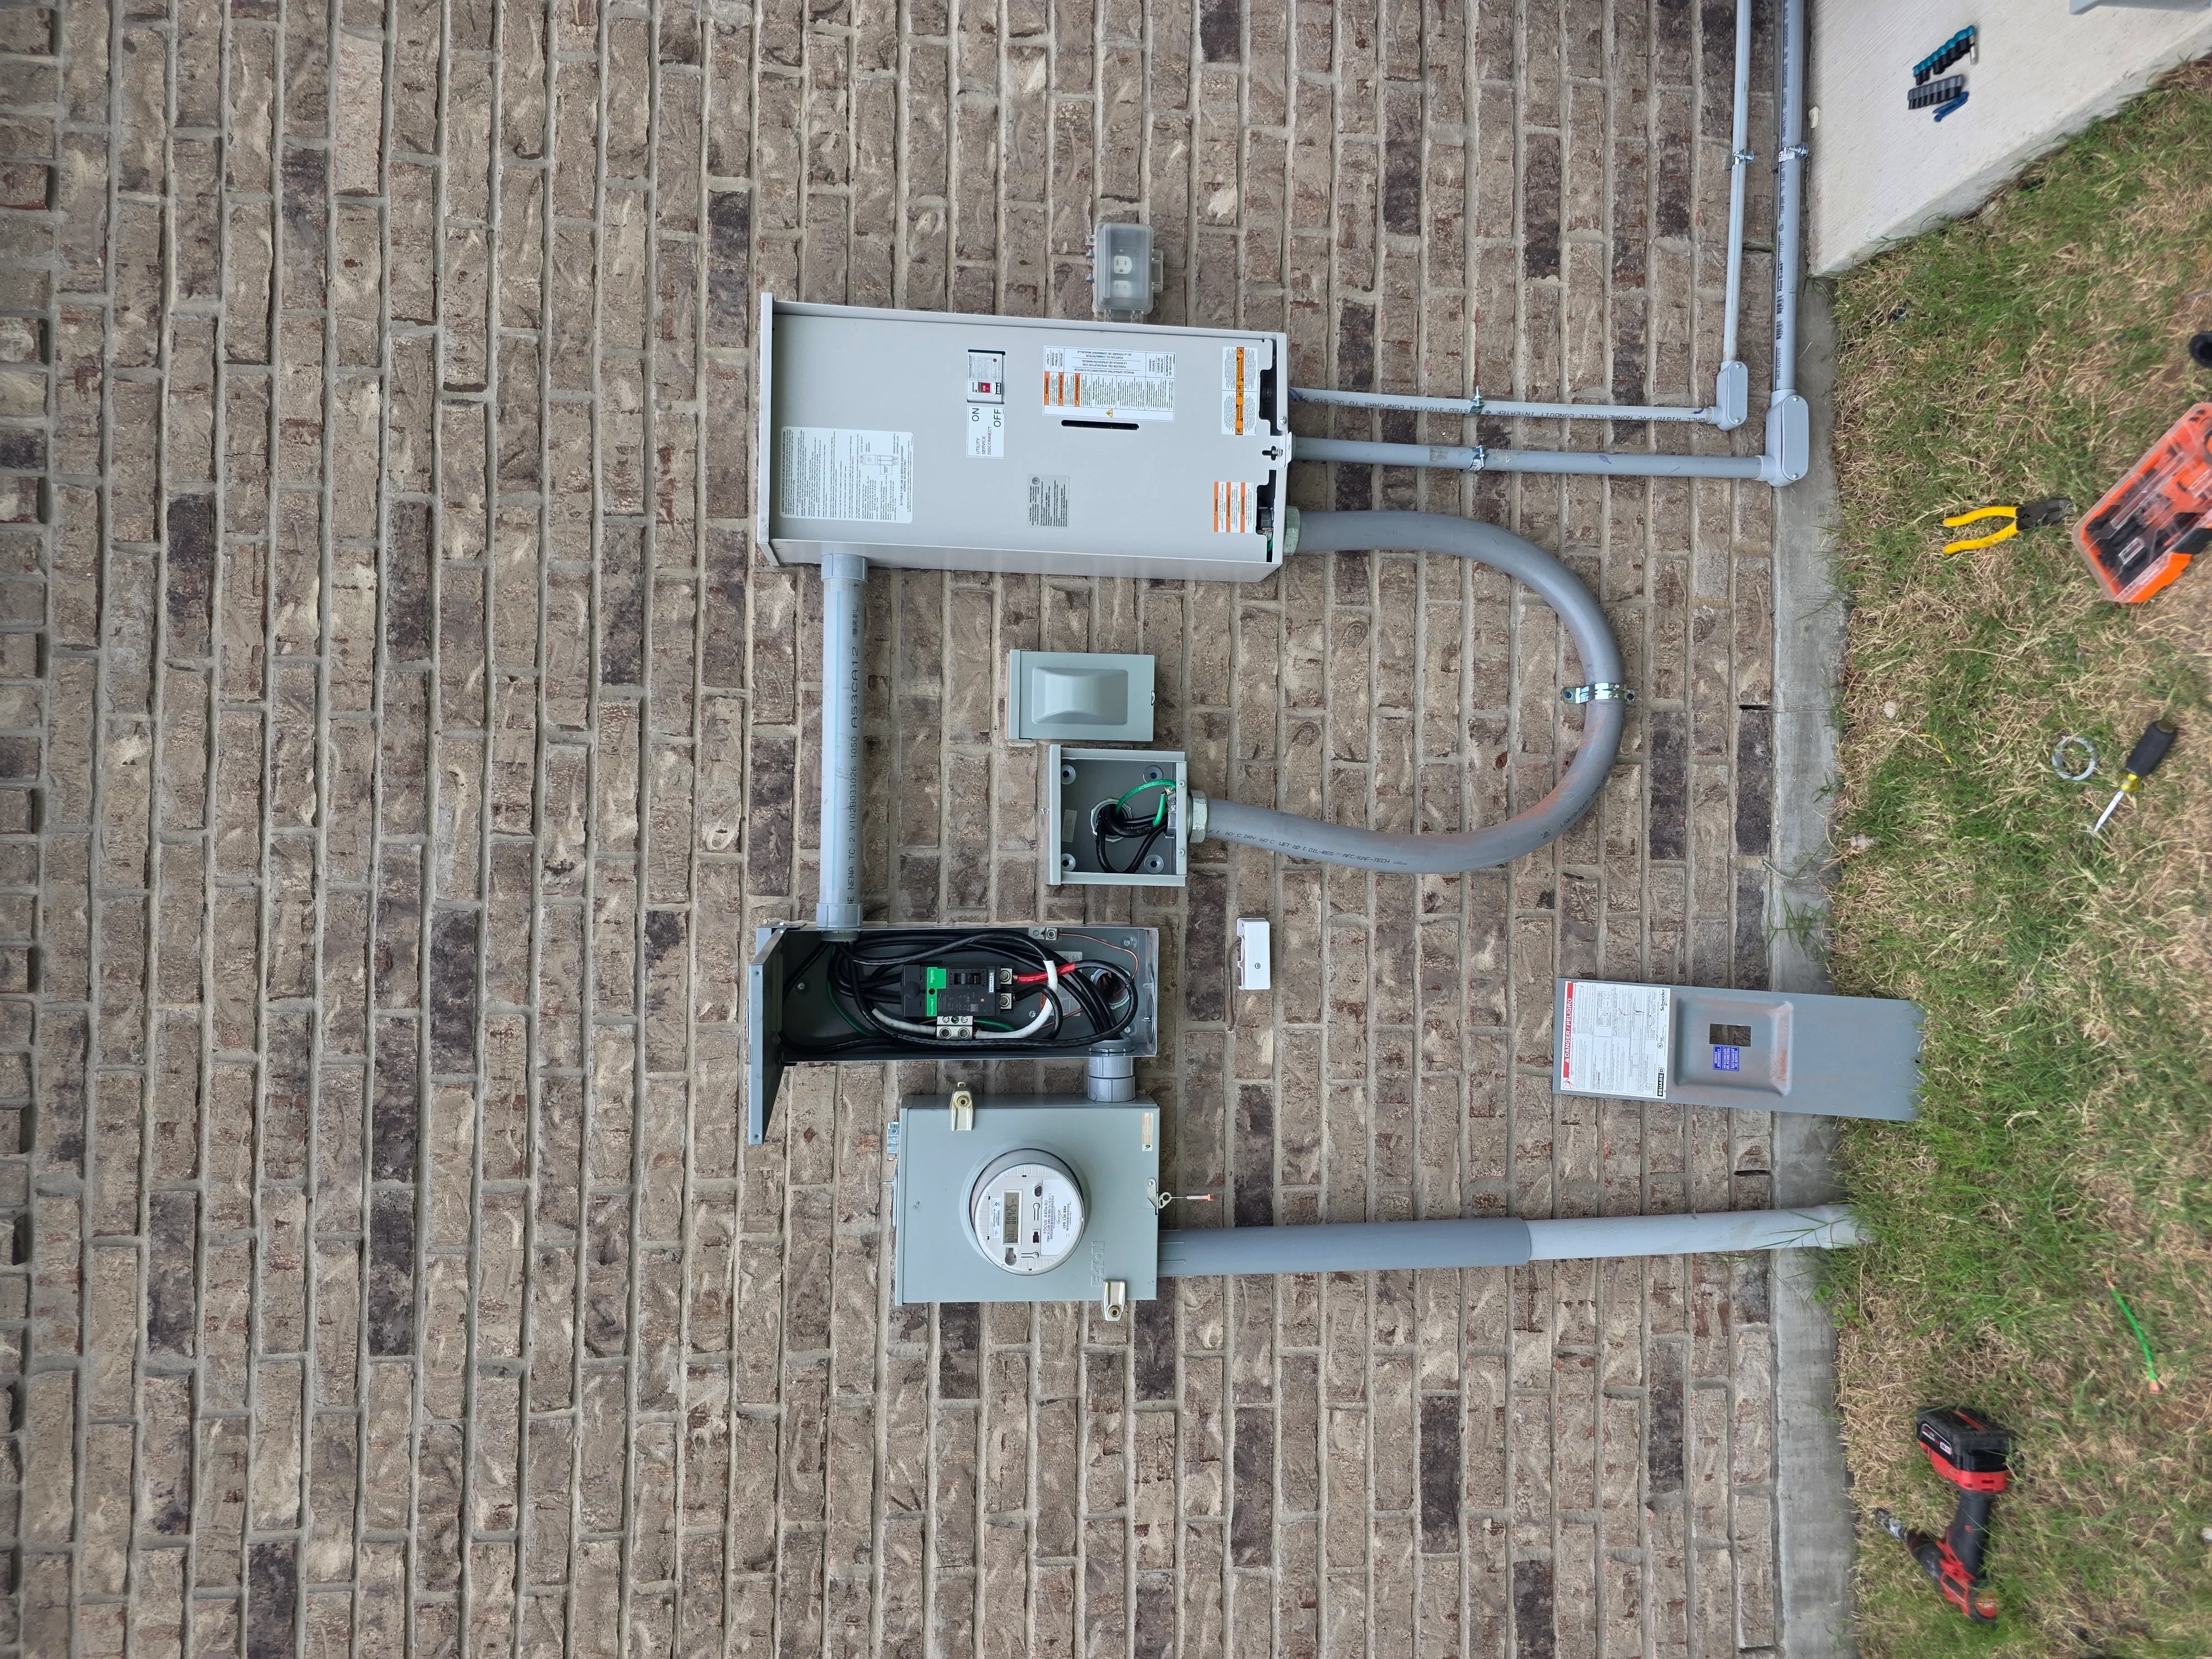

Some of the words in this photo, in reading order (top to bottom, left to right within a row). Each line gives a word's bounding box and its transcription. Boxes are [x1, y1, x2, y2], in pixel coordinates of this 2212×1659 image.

[972, 408, 979, 422] ON
[849, 766, 857, 831] V102B033026
[1308, 848, 1334, 856] OIL-RES
[1342, 853, 1390, 864] AFC/KAF-TECH
[1006, 1204, 1017, 1224] 00425
[1091, 1240, 1105, 1287] EATON
